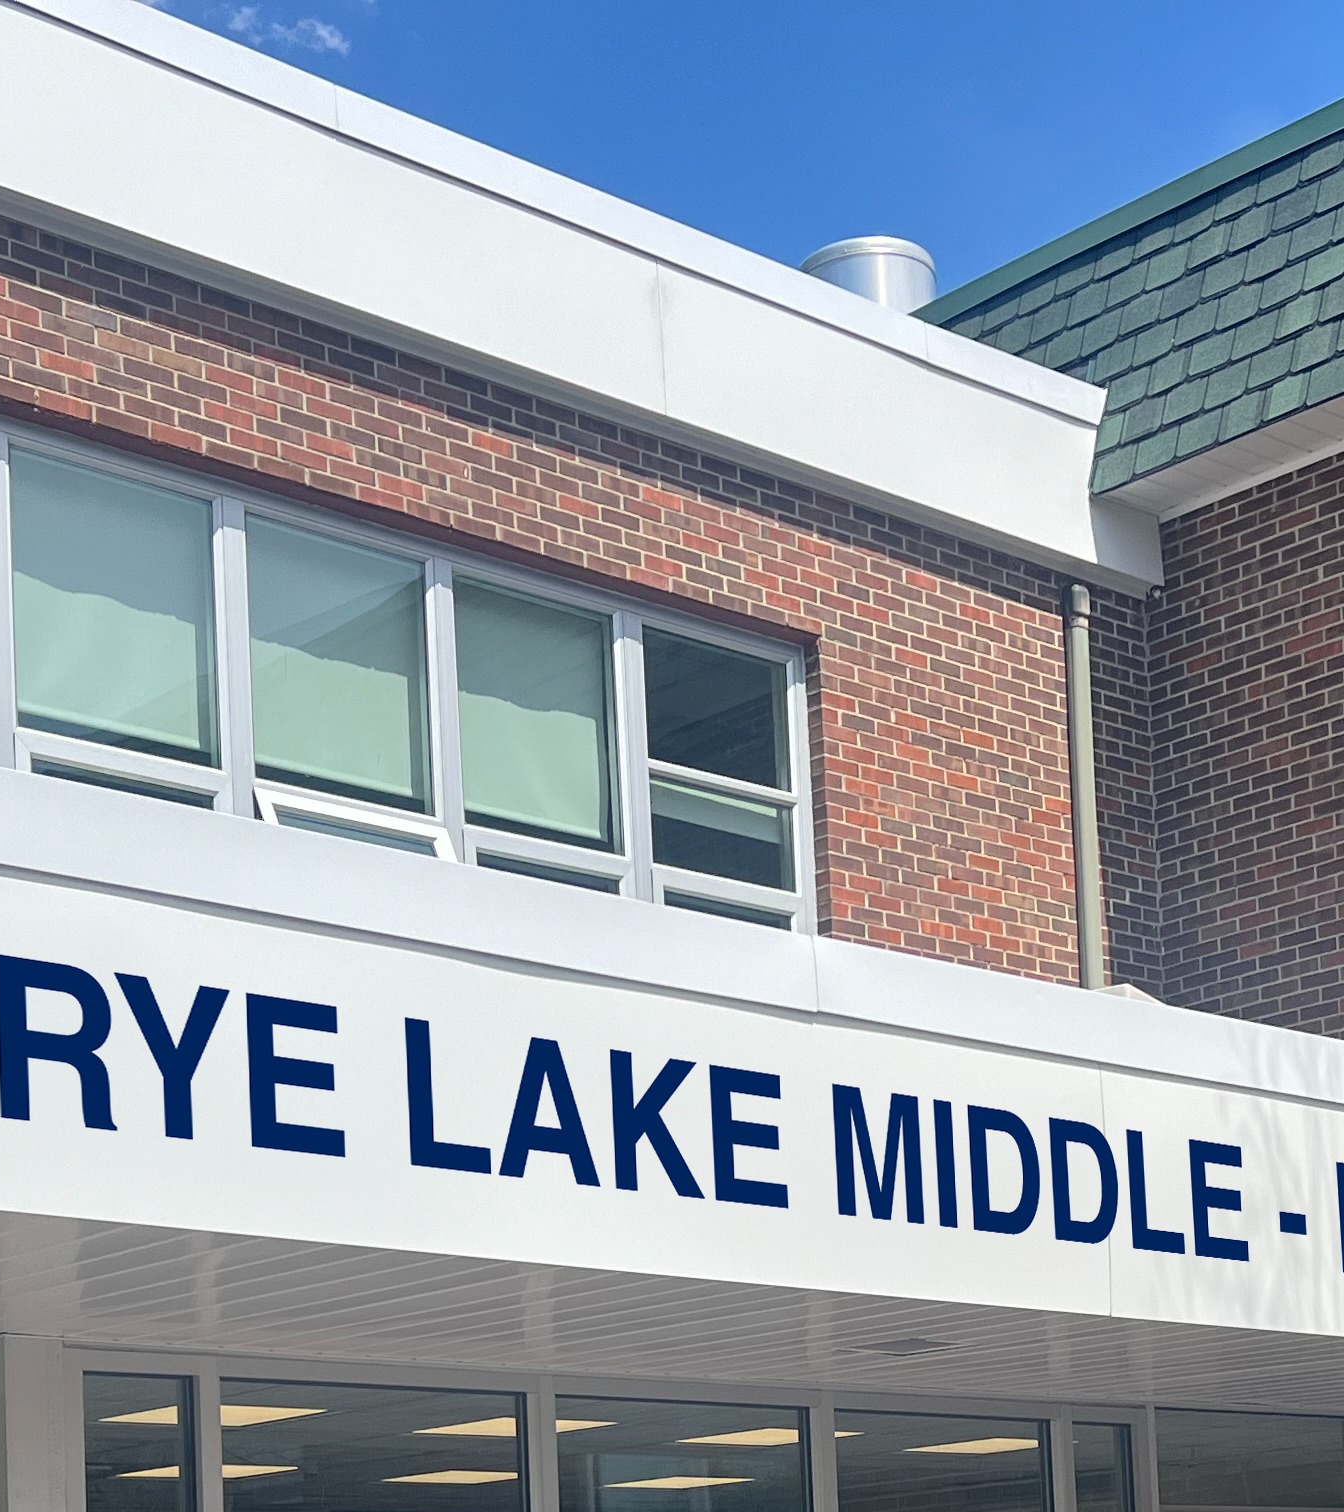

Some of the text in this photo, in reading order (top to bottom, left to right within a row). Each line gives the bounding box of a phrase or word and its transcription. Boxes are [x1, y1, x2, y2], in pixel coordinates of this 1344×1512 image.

[404, 1017, 789, 1209] LAKE
[831, 1083, 1249, 1262] MIDDLE
[1279, 1211, 1307, 1236] -
